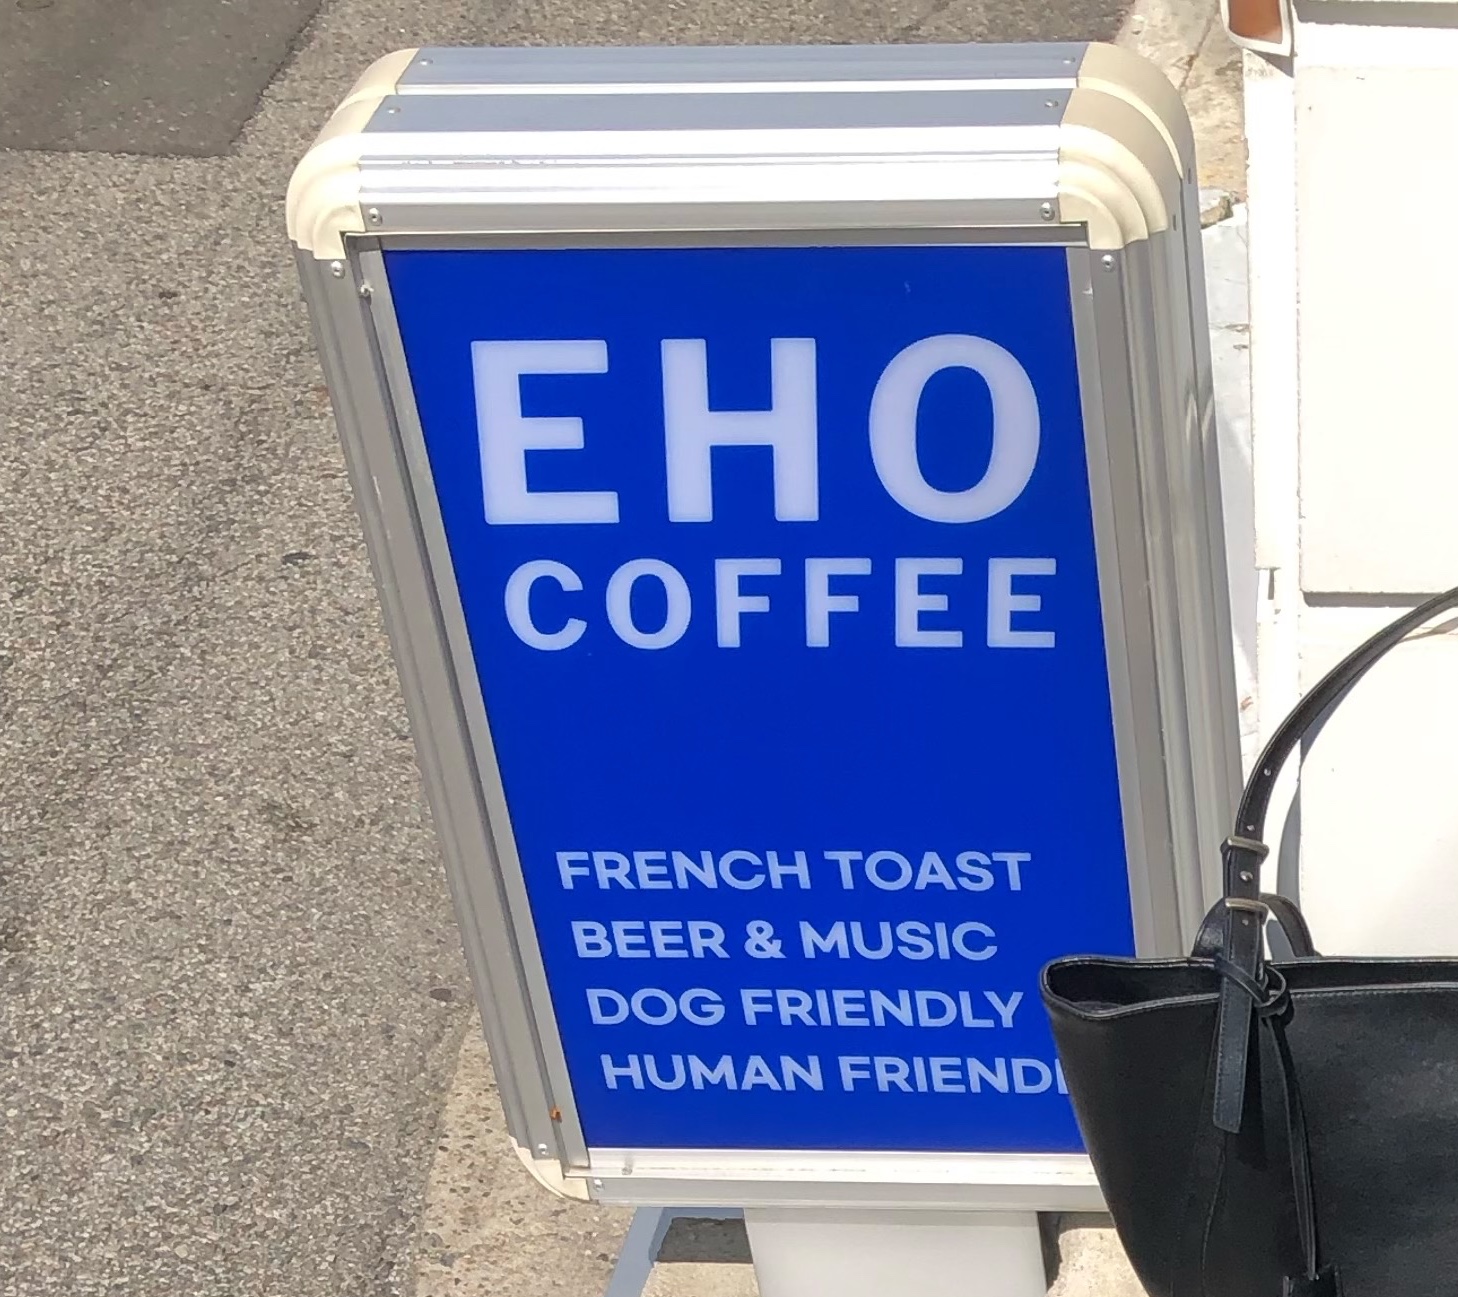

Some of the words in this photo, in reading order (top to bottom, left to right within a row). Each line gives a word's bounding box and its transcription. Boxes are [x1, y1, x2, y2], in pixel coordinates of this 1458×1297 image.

[470, 334, 1041, 525] EHO
[504, 557, 1057, 651] COFFEE
[556, 850, 811, 890] FRENCH
[824, 850, 1031, 891] TOAST
[571, 920, 730, 959] BEER
[744, 920, 786, 960] &
[799, 921, 998, 961] MUSIC
[586, 988, 725, 1026] DOG
[740, 989, 1024, 1028] FRIENDLY
[600, 1054, 824, 1091] HUMAN
